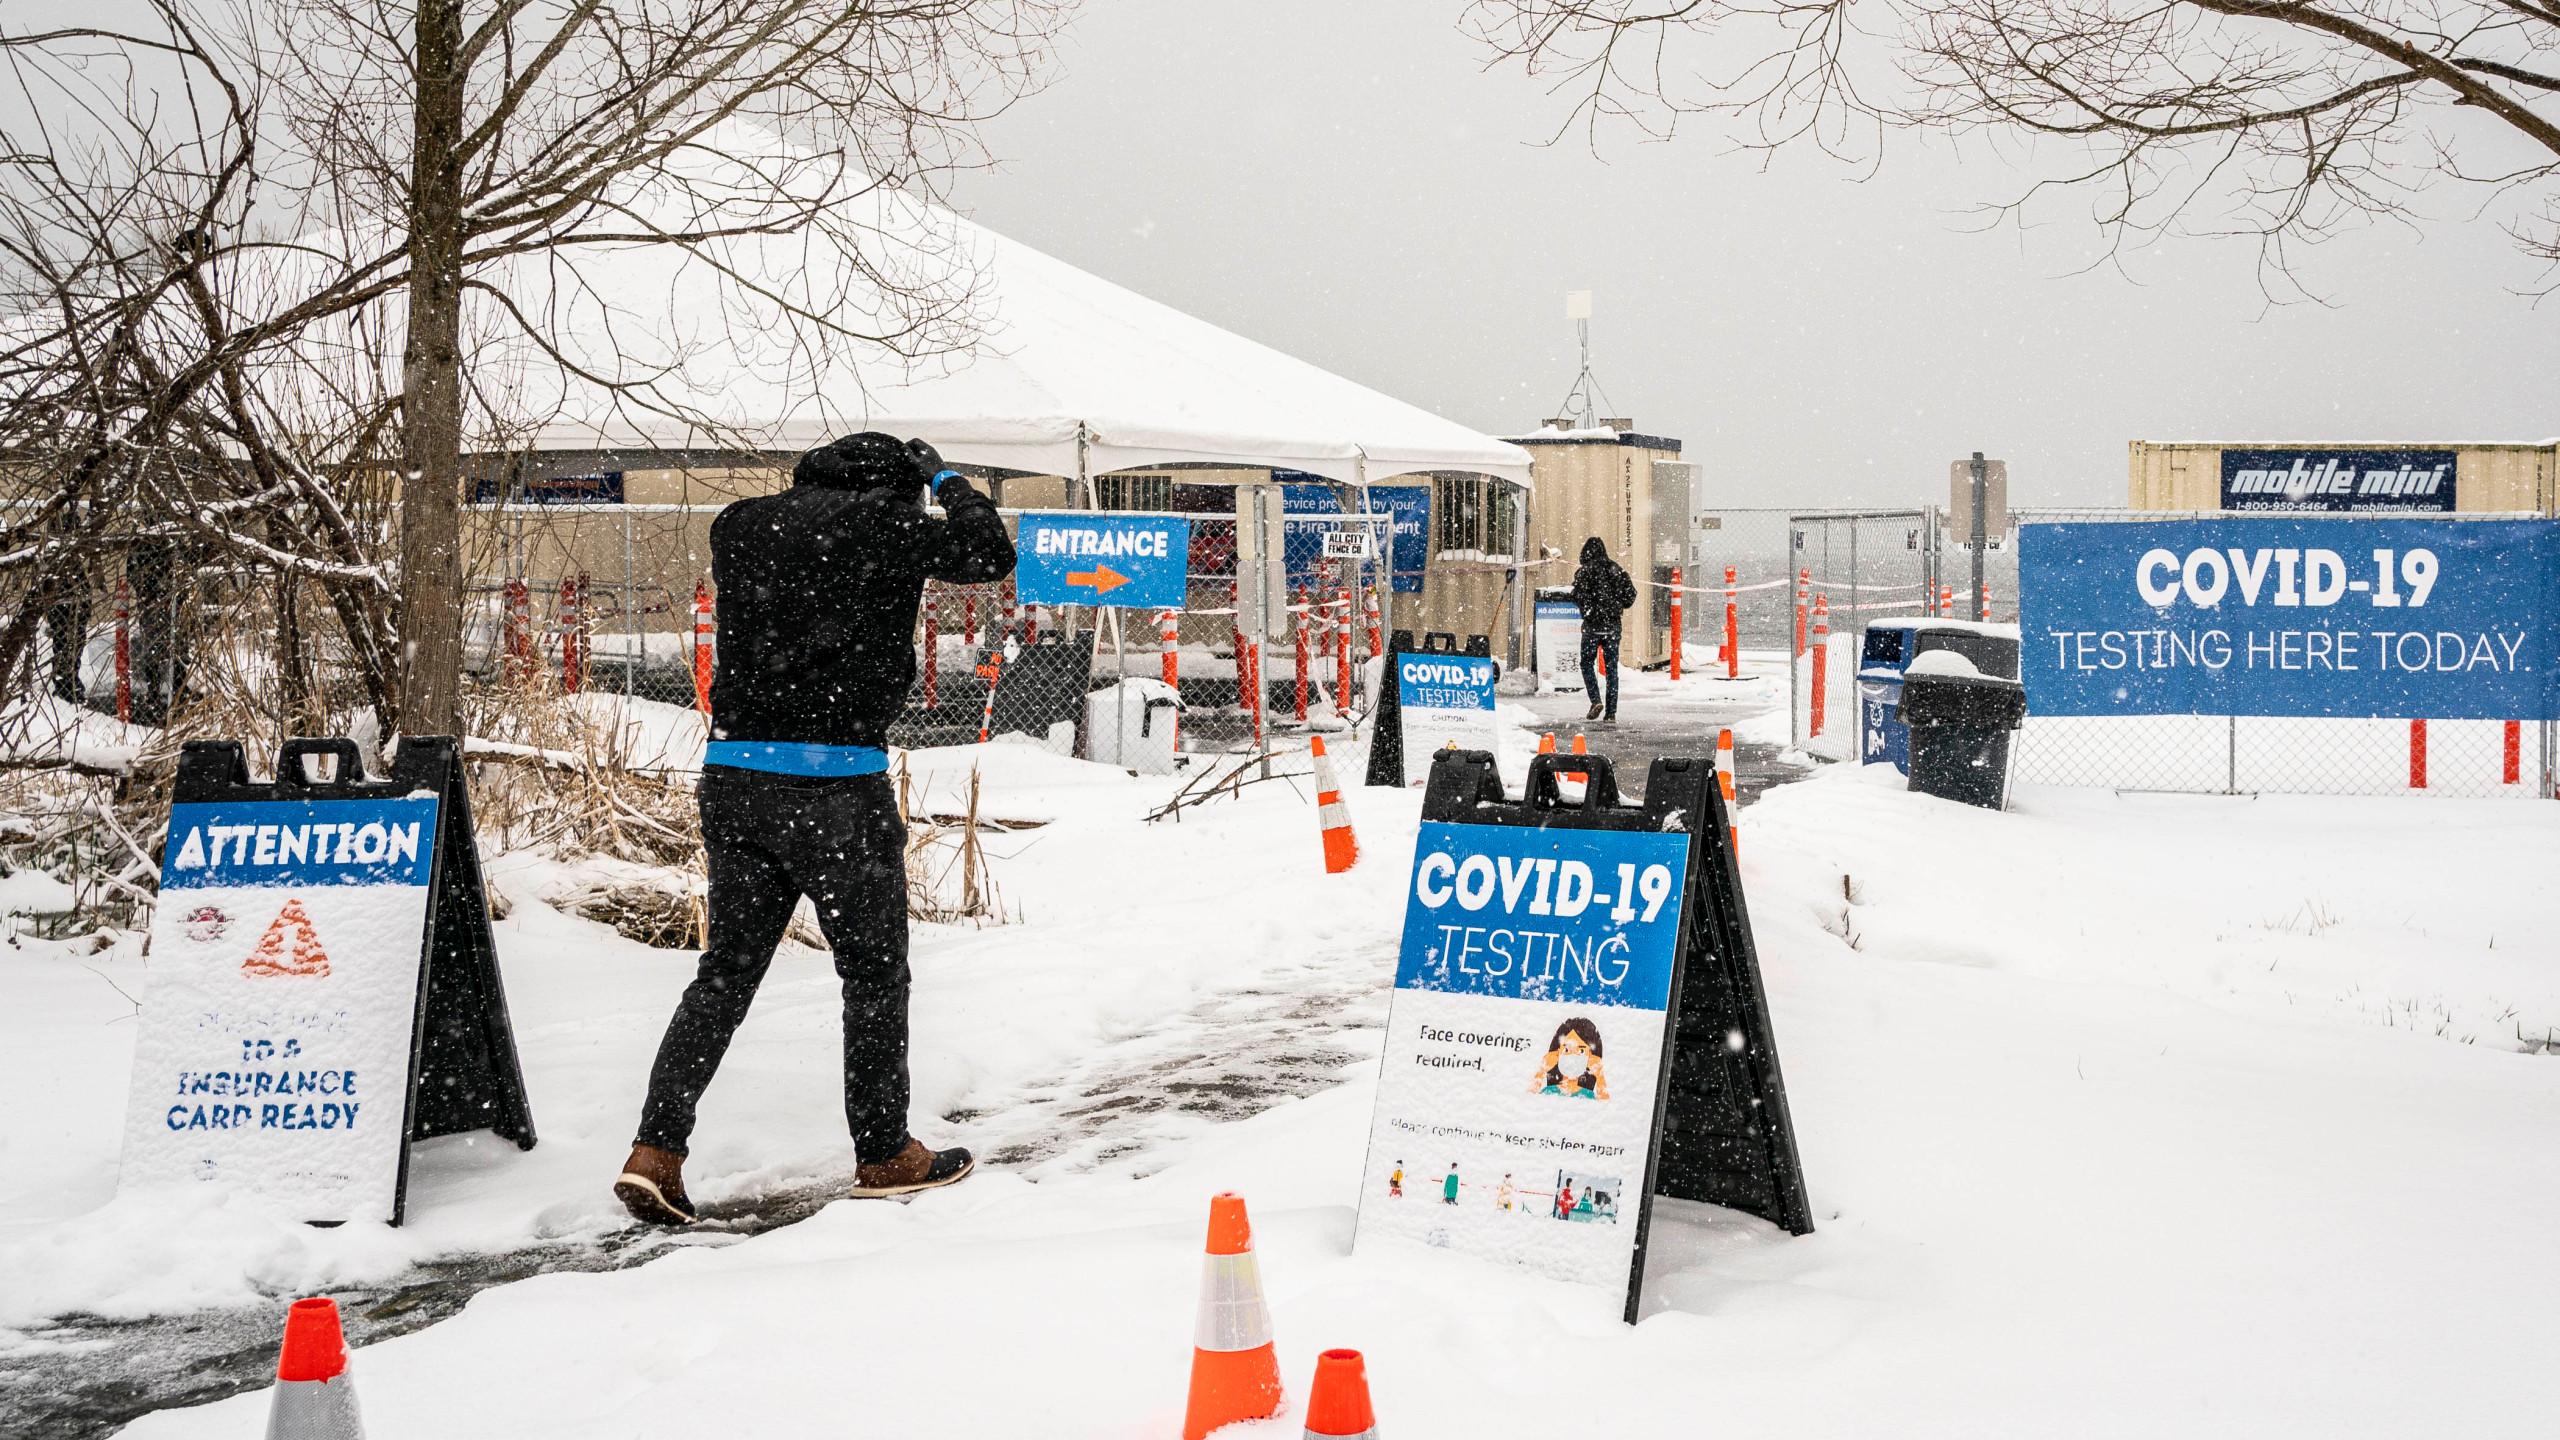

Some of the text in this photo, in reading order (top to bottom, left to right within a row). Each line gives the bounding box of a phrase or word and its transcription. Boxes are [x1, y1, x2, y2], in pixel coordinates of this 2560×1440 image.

[2230, 458, 2446, 496] mobile mini
[1283, 497, 1315, 509] ervice
[1373, 498, 1386, 512] by
[1390, 500, 1416, 512] your
[2235, 501, 2442, 512] 1-800-950-6464 mobilemini.com
[1299, 520, 1326, 534] Fire
[1328, 533, 1365, 543] ALL CITY
[1035, 528, 1168, 557] ENTRANCE
[1328, 545, 1350, 553] FENCE
[2136, 548, 2439, 607] COVID-19
[2050, 630, 2232, 669] TESTING
[2248, 630, 2359, 670] HERE
[1403, 663, 1490, 685] COVID-19
[1417, 688, 1480, 705] TESTING
[174, 822, 421, 868] ATTENTION
[1417, 852, 1672, 923] COVID-19
[1437, 925, 1631, 985] TESTING
[243, 1039, 275, 1061] ID
[1420, 1025, 1531, 1052] Face coverings
[1415, 1053, 1485, 1072] required.
[177, 1070, 358, 1097] INSURANCE
[167, 1103, 361, 1131] CARD READY
